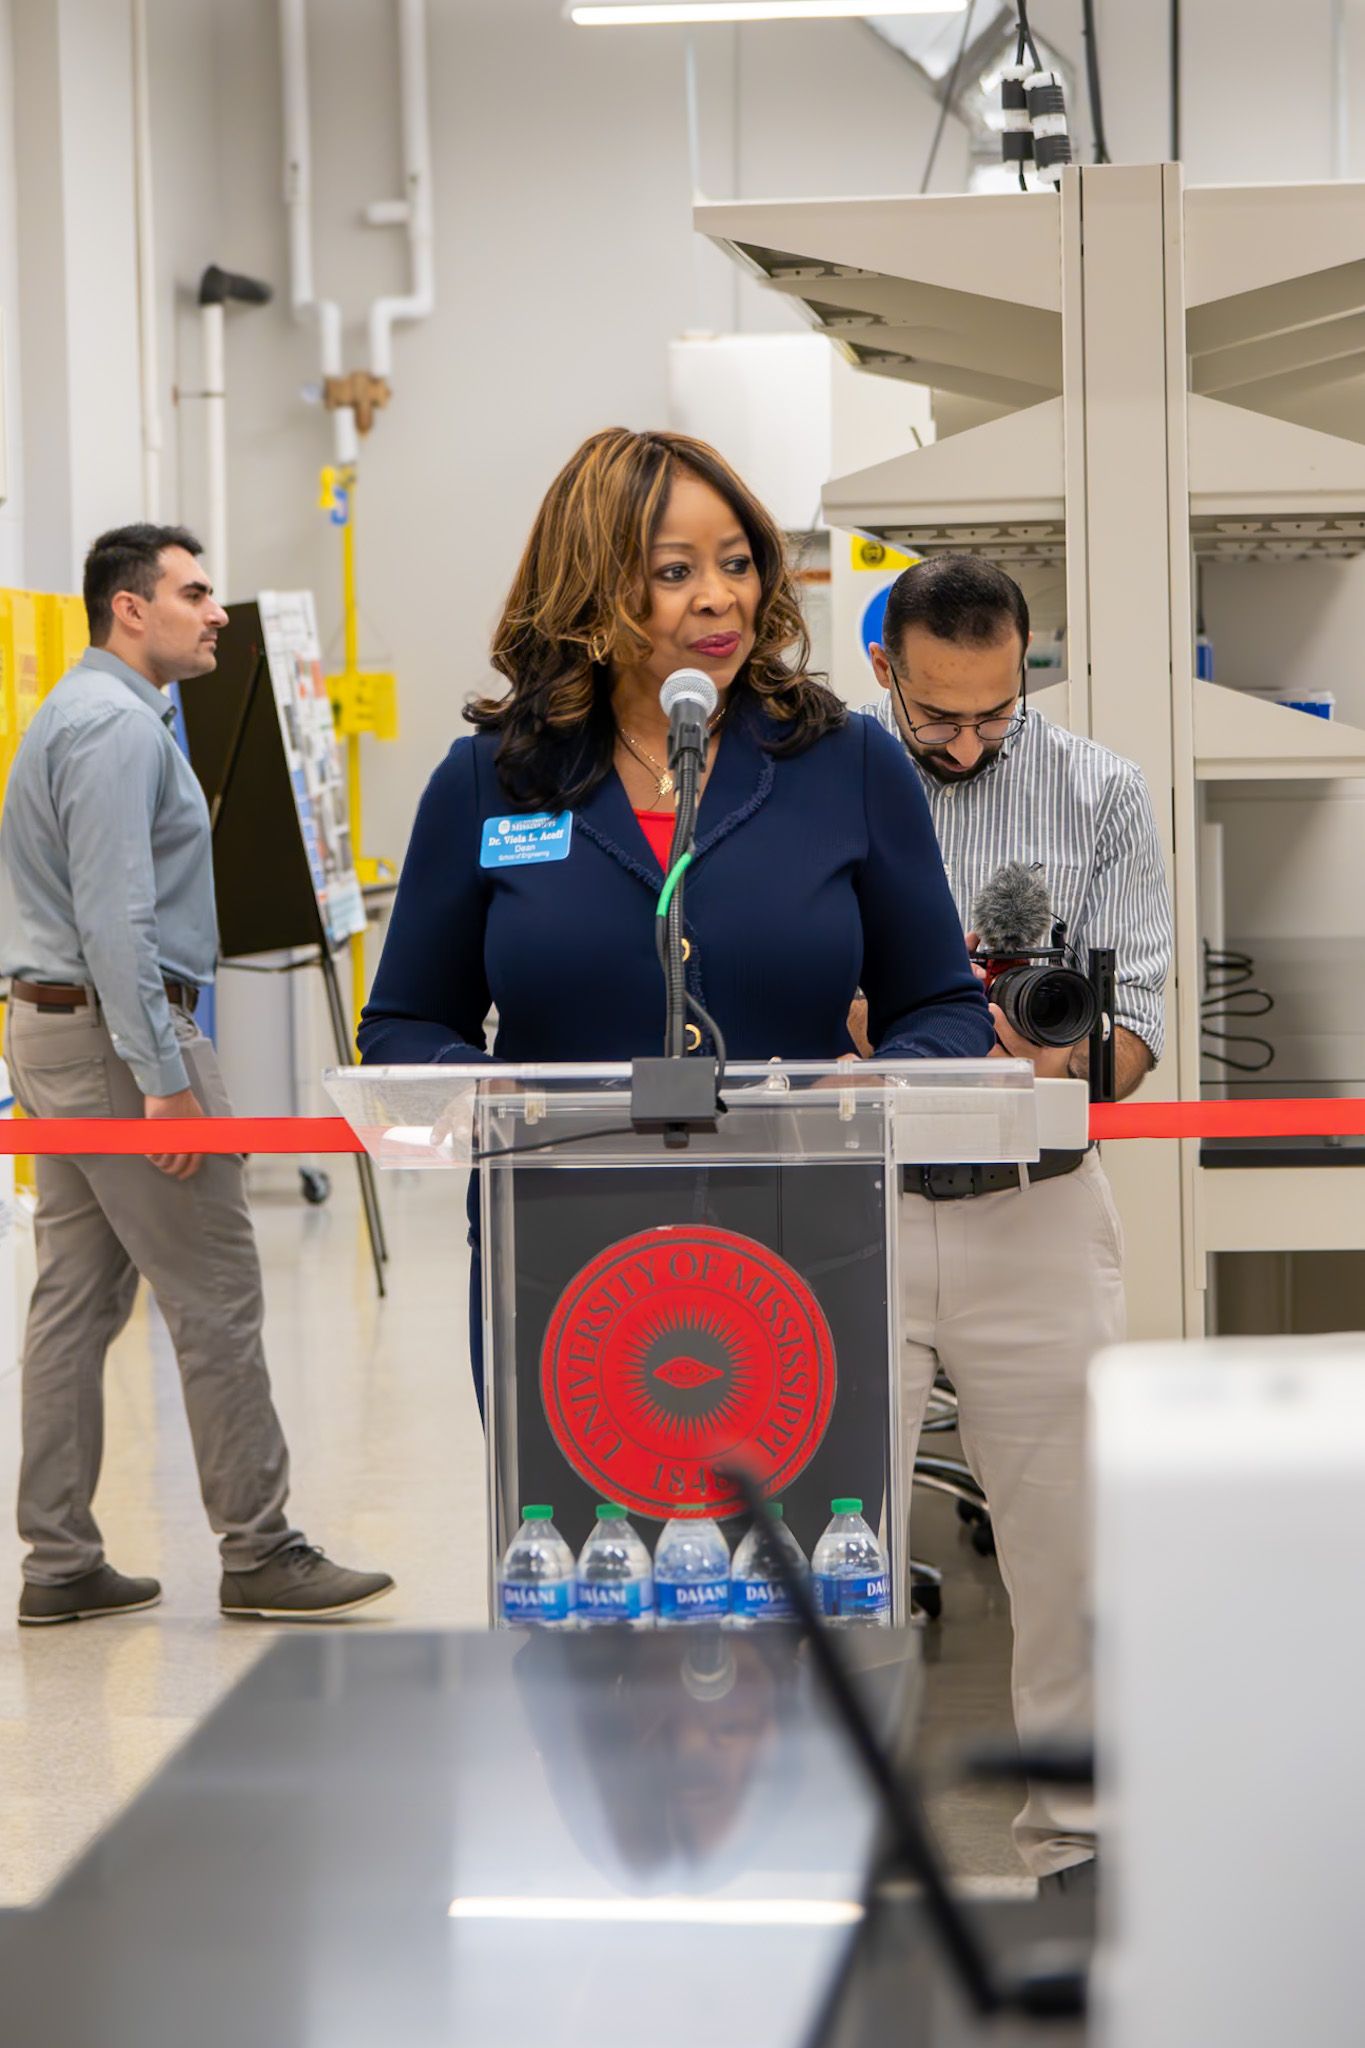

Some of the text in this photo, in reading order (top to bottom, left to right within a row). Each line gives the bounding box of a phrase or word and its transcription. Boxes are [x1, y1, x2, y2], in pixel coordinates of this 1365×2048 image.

[488, 829, 565, 847] Dr. Viola L. Acoff
[514, 844, 536, 853] Dean
[568, 1250, 811, 1461] UNIVERSITY OF MISSISSIPPI
[676, 1584, 727, 1604] DASAN
[746, 1583, 786, 1602] DASA
